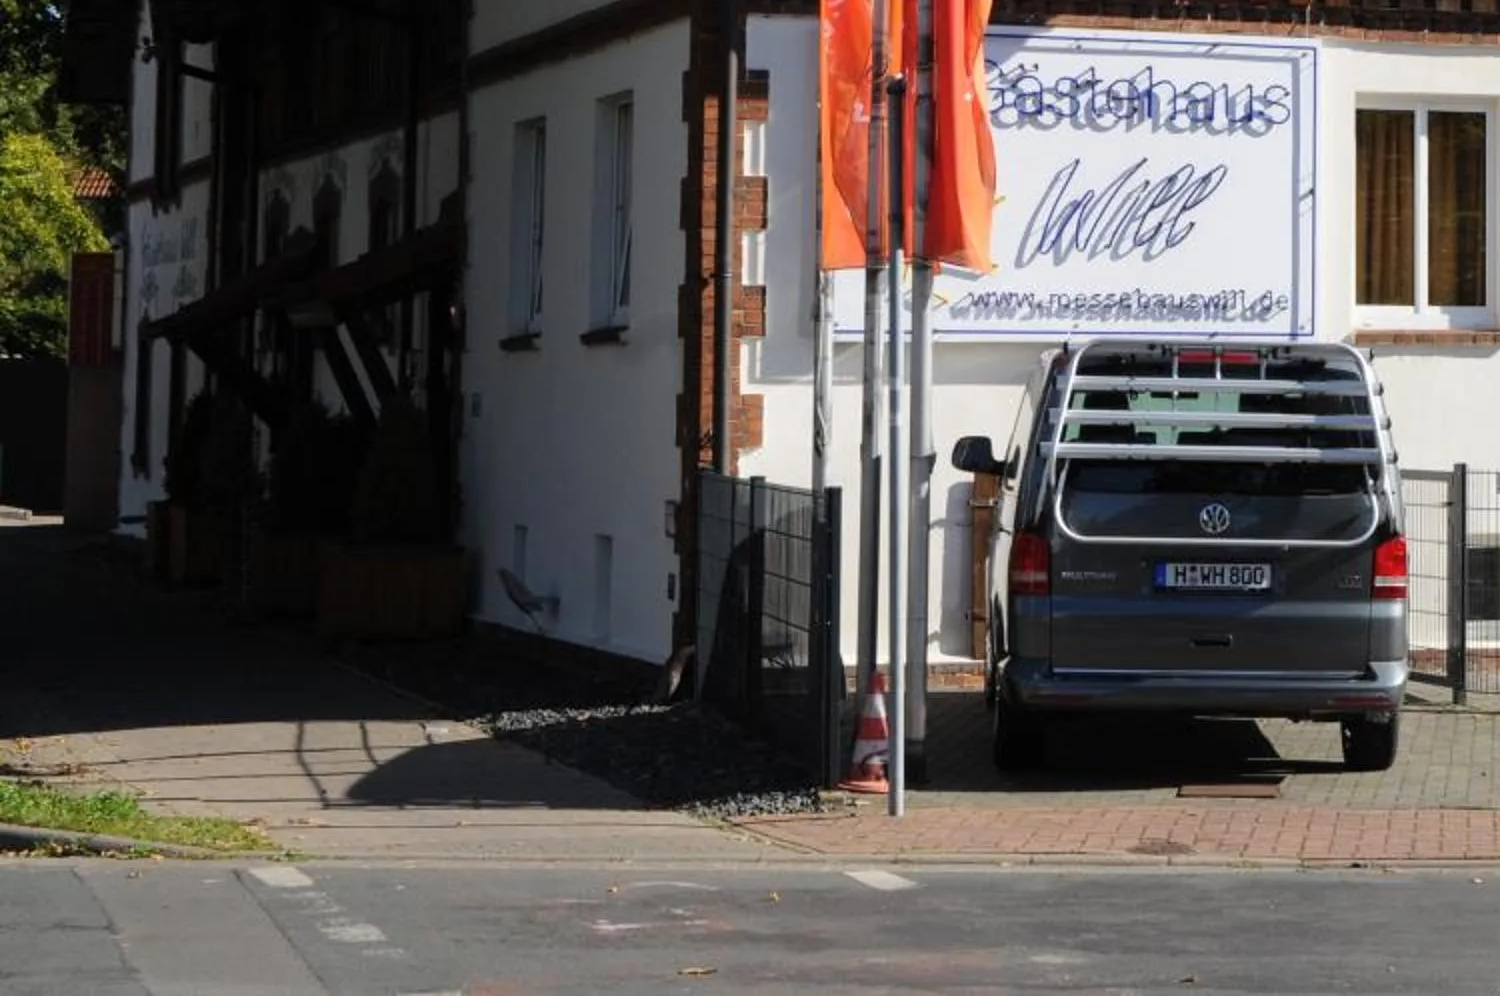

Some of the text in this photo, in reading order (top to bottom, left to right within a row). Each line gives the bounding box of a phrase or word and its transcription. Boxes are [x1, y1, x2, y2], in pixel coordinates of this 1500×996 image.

[1175, 565, 1265, 585] H WH 800
